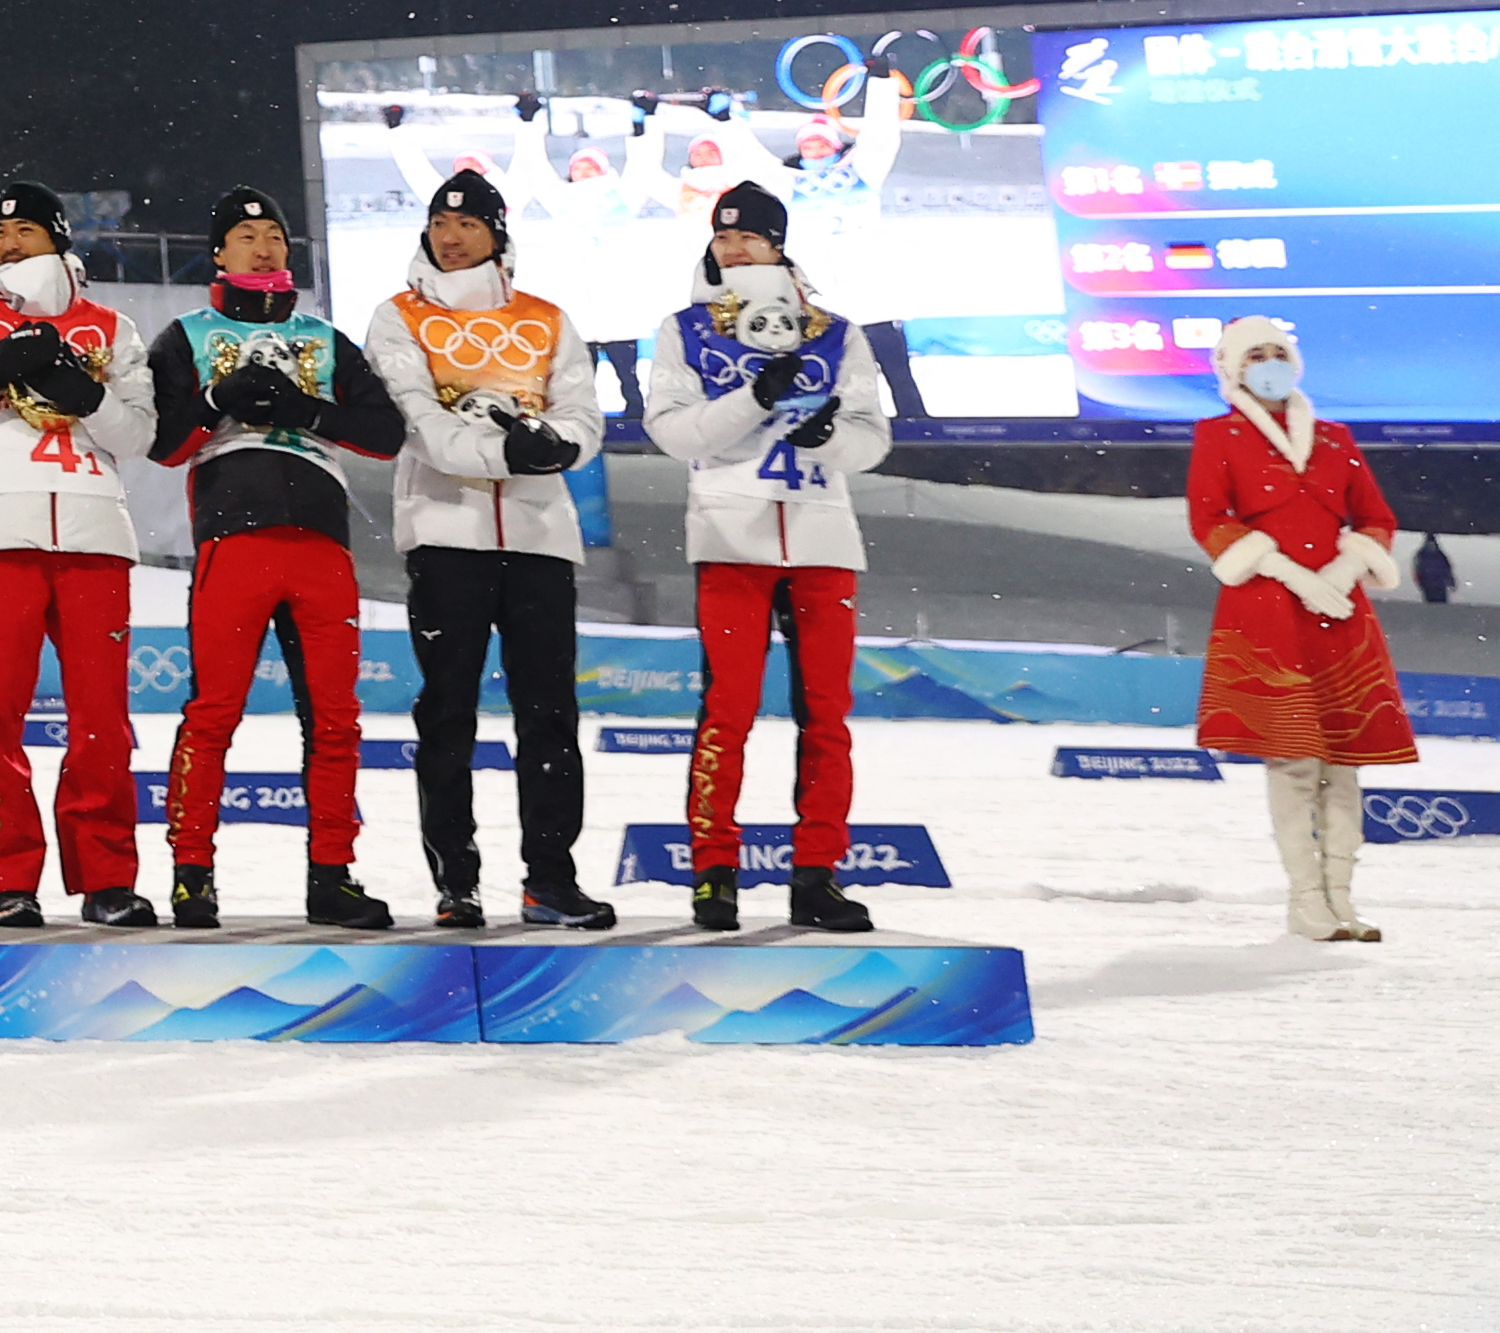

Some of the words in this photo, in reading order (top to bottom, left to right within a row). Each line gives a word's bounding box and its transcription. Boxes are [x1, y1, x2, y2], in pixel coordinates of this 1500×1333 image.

[30, 417, 83, 474] 4
[80, 451, 104, 477] 1
[758, 439, 804, 491] 4
[809, 464, 828, 489] 4
[597, 666, 682, 694] BEIJING
